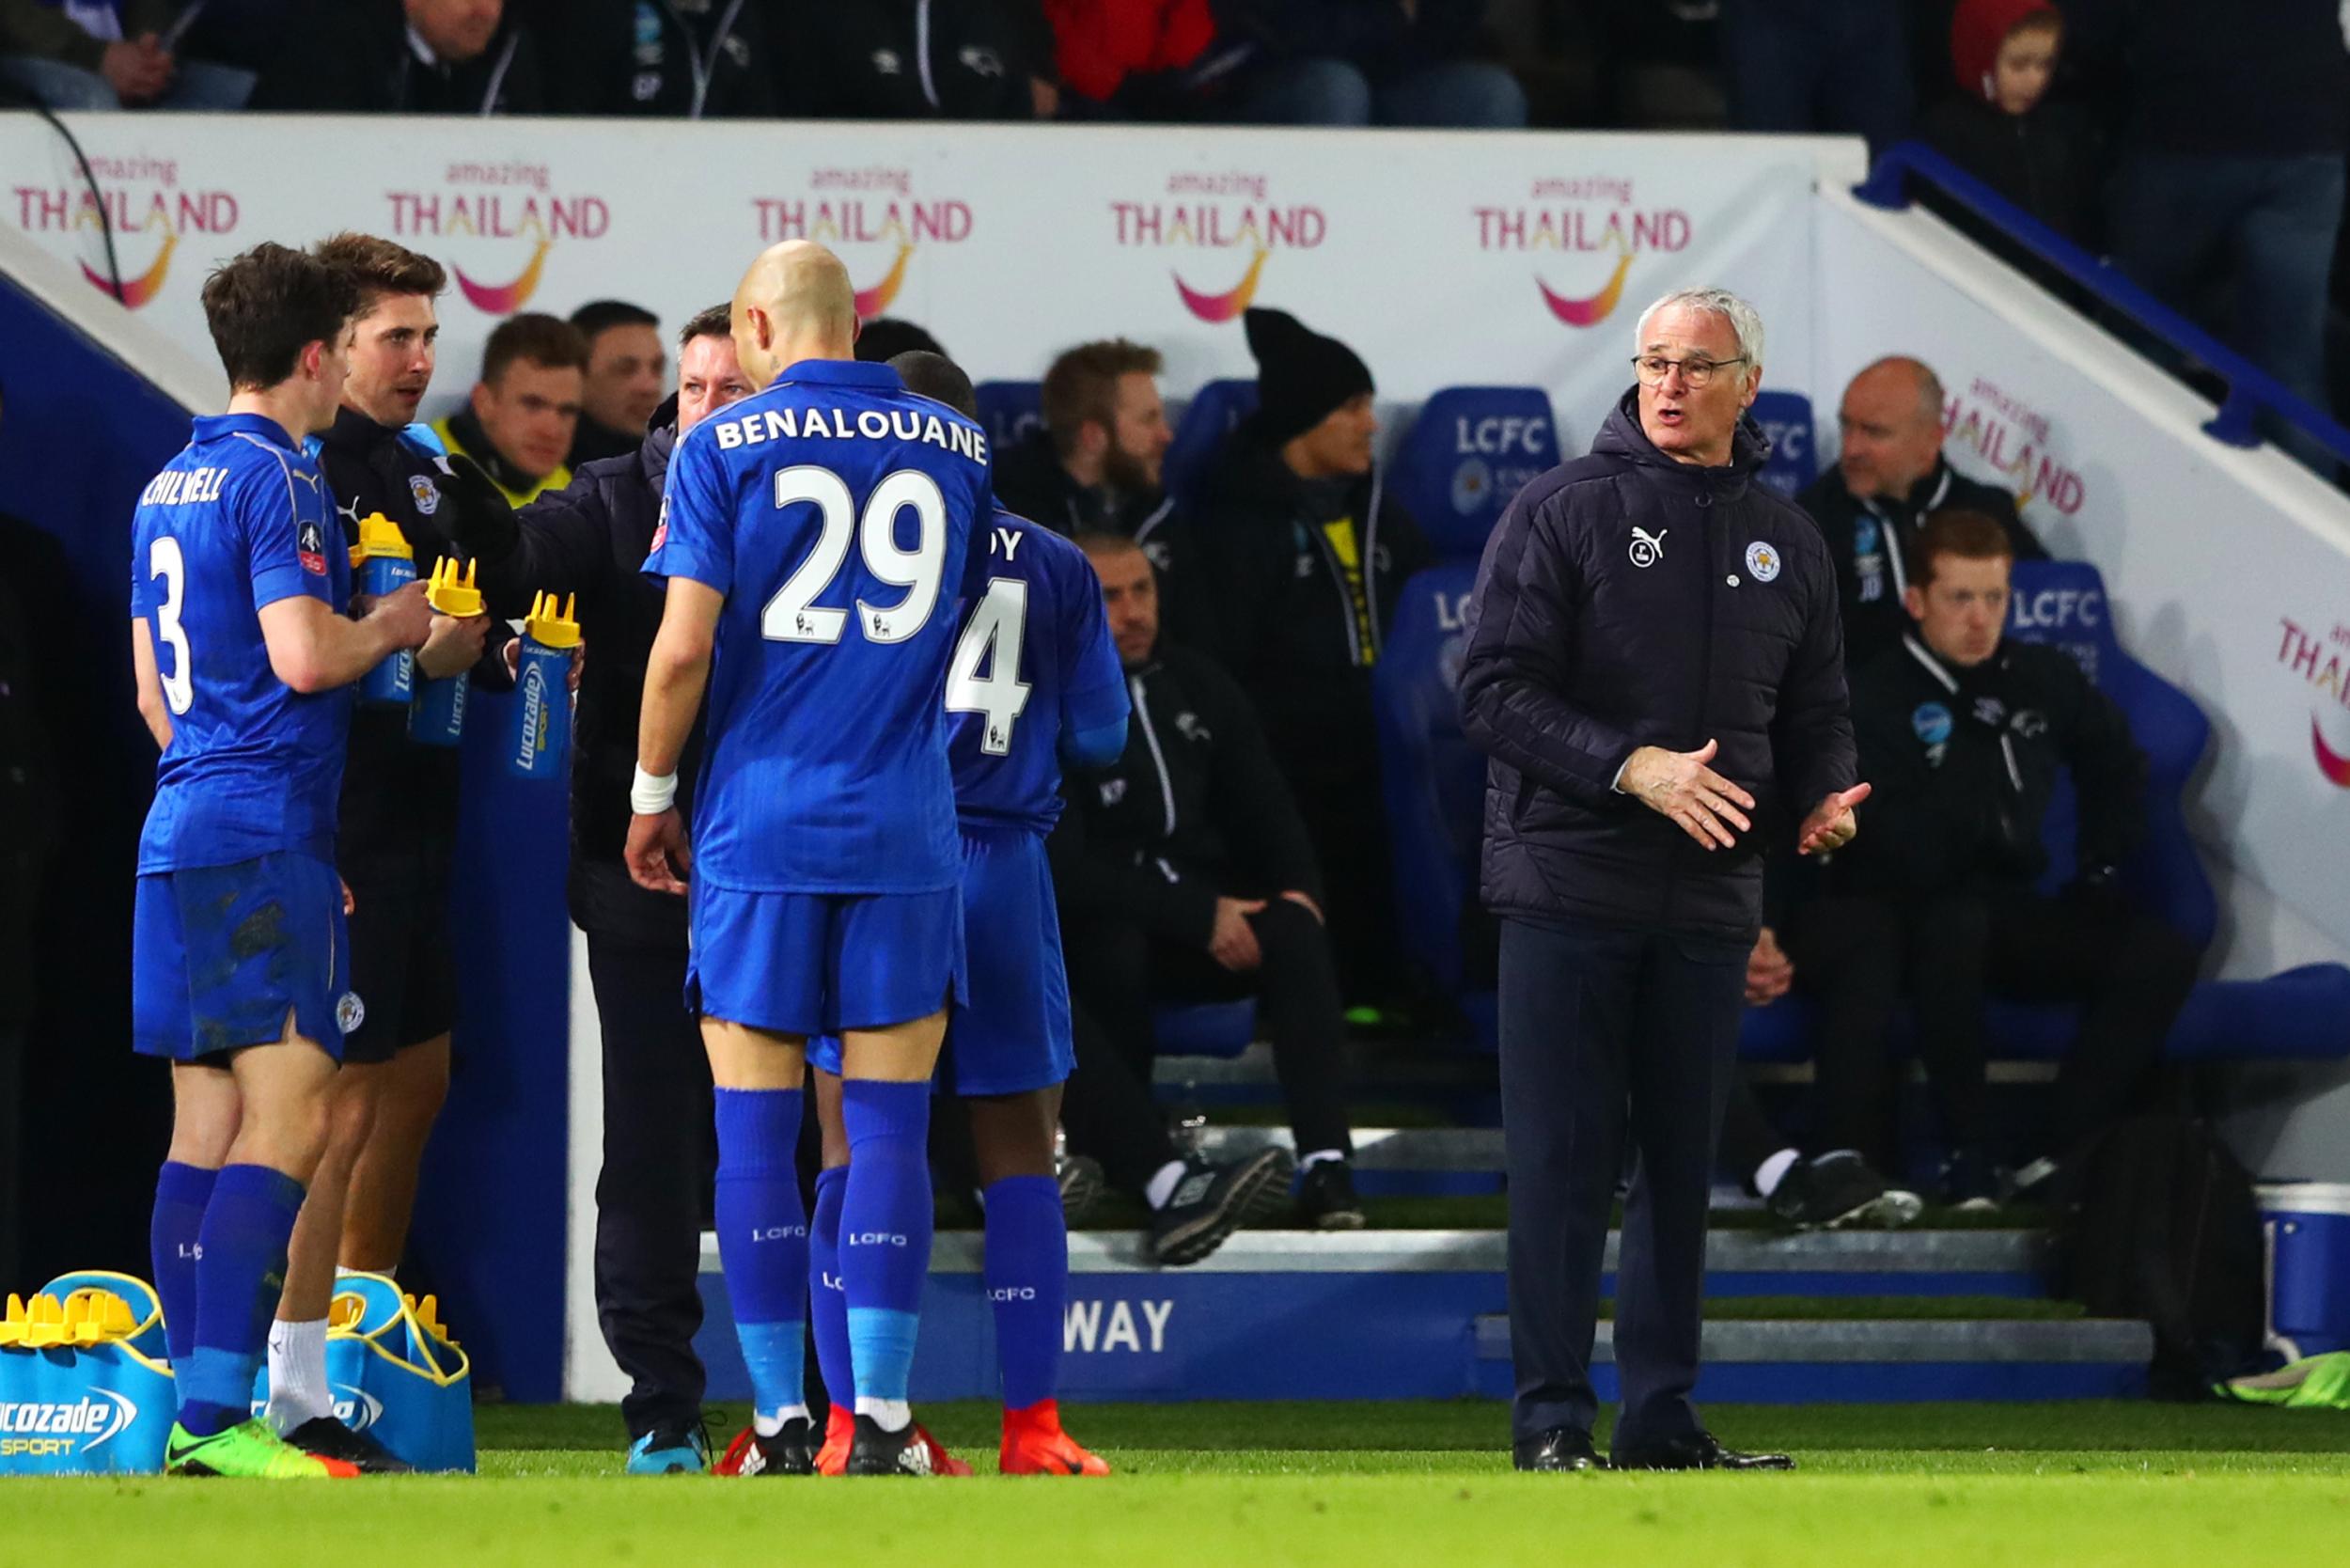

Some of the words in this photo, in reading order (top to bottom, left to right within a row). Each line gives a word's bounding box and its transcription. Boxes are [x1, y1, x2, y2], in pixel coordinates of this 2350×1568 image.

[446, 162, 550, 190] amazing
[809, 165, 911, 196] amazing
[1166, 169, 1267, 199] amazing
[1531, 176, 1633, 205] amazing
[13, 187, 239, 232] THAILAND
[385, 194, 610, 239] THAILAND
[753, 198, 973, 243] THAILAND
[1112, 203, 1326, 248] THAILAND
[1474, 209, 1692, 252] THAILAND
[714, 407, 990, 466] BENALOUANE
[1456, 416, 1547, 454] LCFC
[1760, 419, 1808, 461] FC
[1942, 392, 2085, 515] HAILAND
[141, 467, 229, 507] CHILWELL
[760, 464, 948, 645] 29
[149, 536, 195, 716] 3
[2012, 588, 2102, 628] LCFC
[516, 677, 540, 771] Lucozade
[752, 1225, 807, 1243] LCFC
[849, 1232, 907, 1247] LCFC
[1063, 1299, 1174, 1352] WAY
[0, 1438, 76, 1456] SPORT
